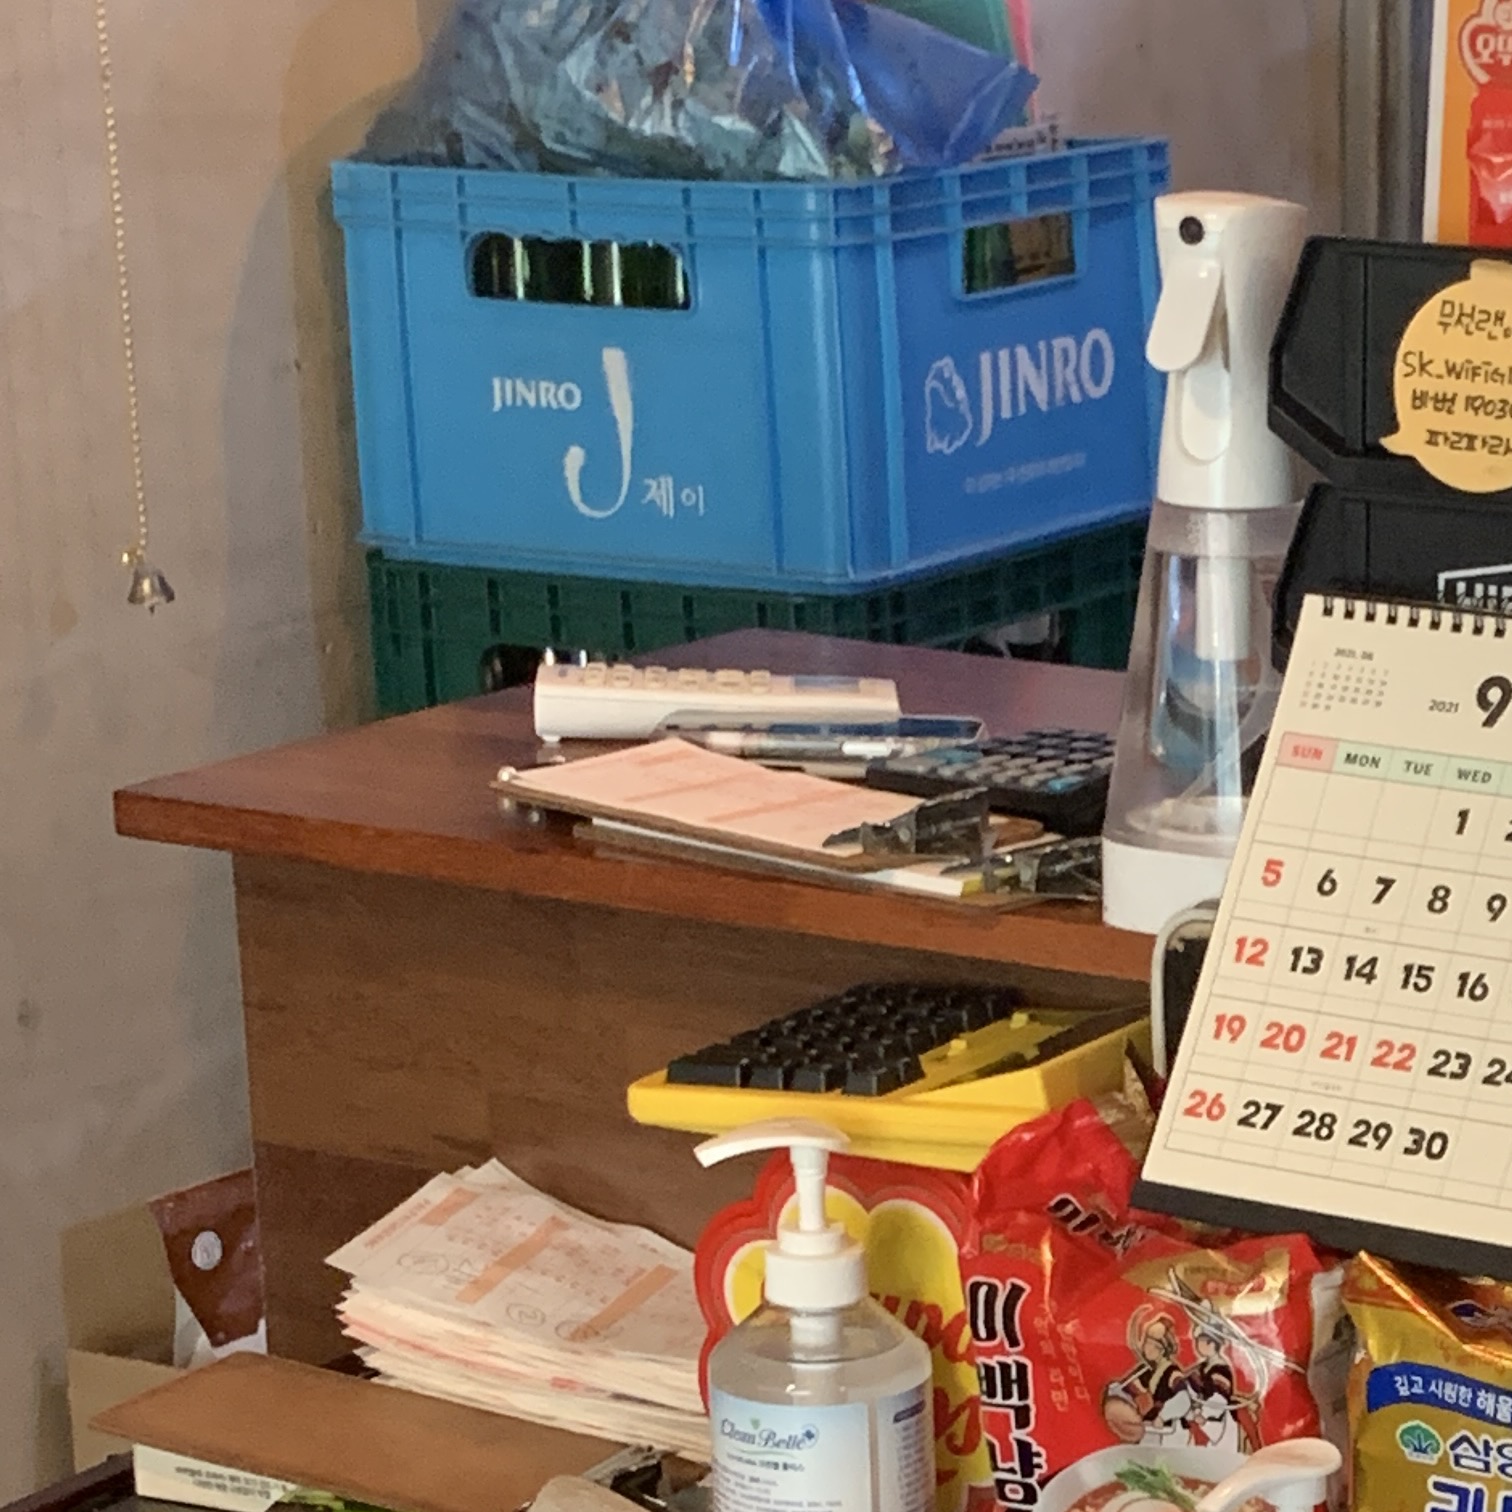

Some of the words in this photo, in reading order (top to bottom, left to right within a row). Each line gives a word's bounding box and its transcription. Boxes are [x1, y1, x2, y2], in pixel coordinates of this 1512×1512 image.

[492, 376, 583, 412] JINRO
[975, 327, 1115, 448] JINRO
[641, 475, 706, 518] 제이
[1428, 699, 1460, 714] 2021
[1291, 745, 1323, 761] SUN
[1344, 752, 1381, 769] MON
[1404, 760, 1434, 777] TUE
[1456, 767, 1492, 785] WED
[1455, 809, 1470, 836] 1
[1260, 859, 1282, 886] 5
[1316, 869, 1338, 897] 6
[1373, 876, 1396, 904] 7
[1426, 885, 1449, 914] 8
[1486, 894, 1507, 922] 9
[1233, 936, 1269, 966] 12
[1289, 946, 1325, 975] 13
[1343, 954, 1378, 984] 14
[1400, 963, 1435, 992] 15
[1456, 971, 1490, 1001] 16
[1212, 1013, 1247, 1042] 19
[1259, 1022, 1306, 1052] 20
[1319, 1031, 1356, 1061] 21
[1370, 1039, 1417, 1071] 22
[1426, 1049, 1472, 1079] 23
[1183, 1090, 1227, 1121] 26
[1236, 1099, 1282, 1130] 27
[1291, 1108, 1336, 1141] 28
[1347, 1118, 1393, 1150] 29
[1402, 1127, 1449, 1160] 30
[1428, 1381, 1475, 1406] 시원한
